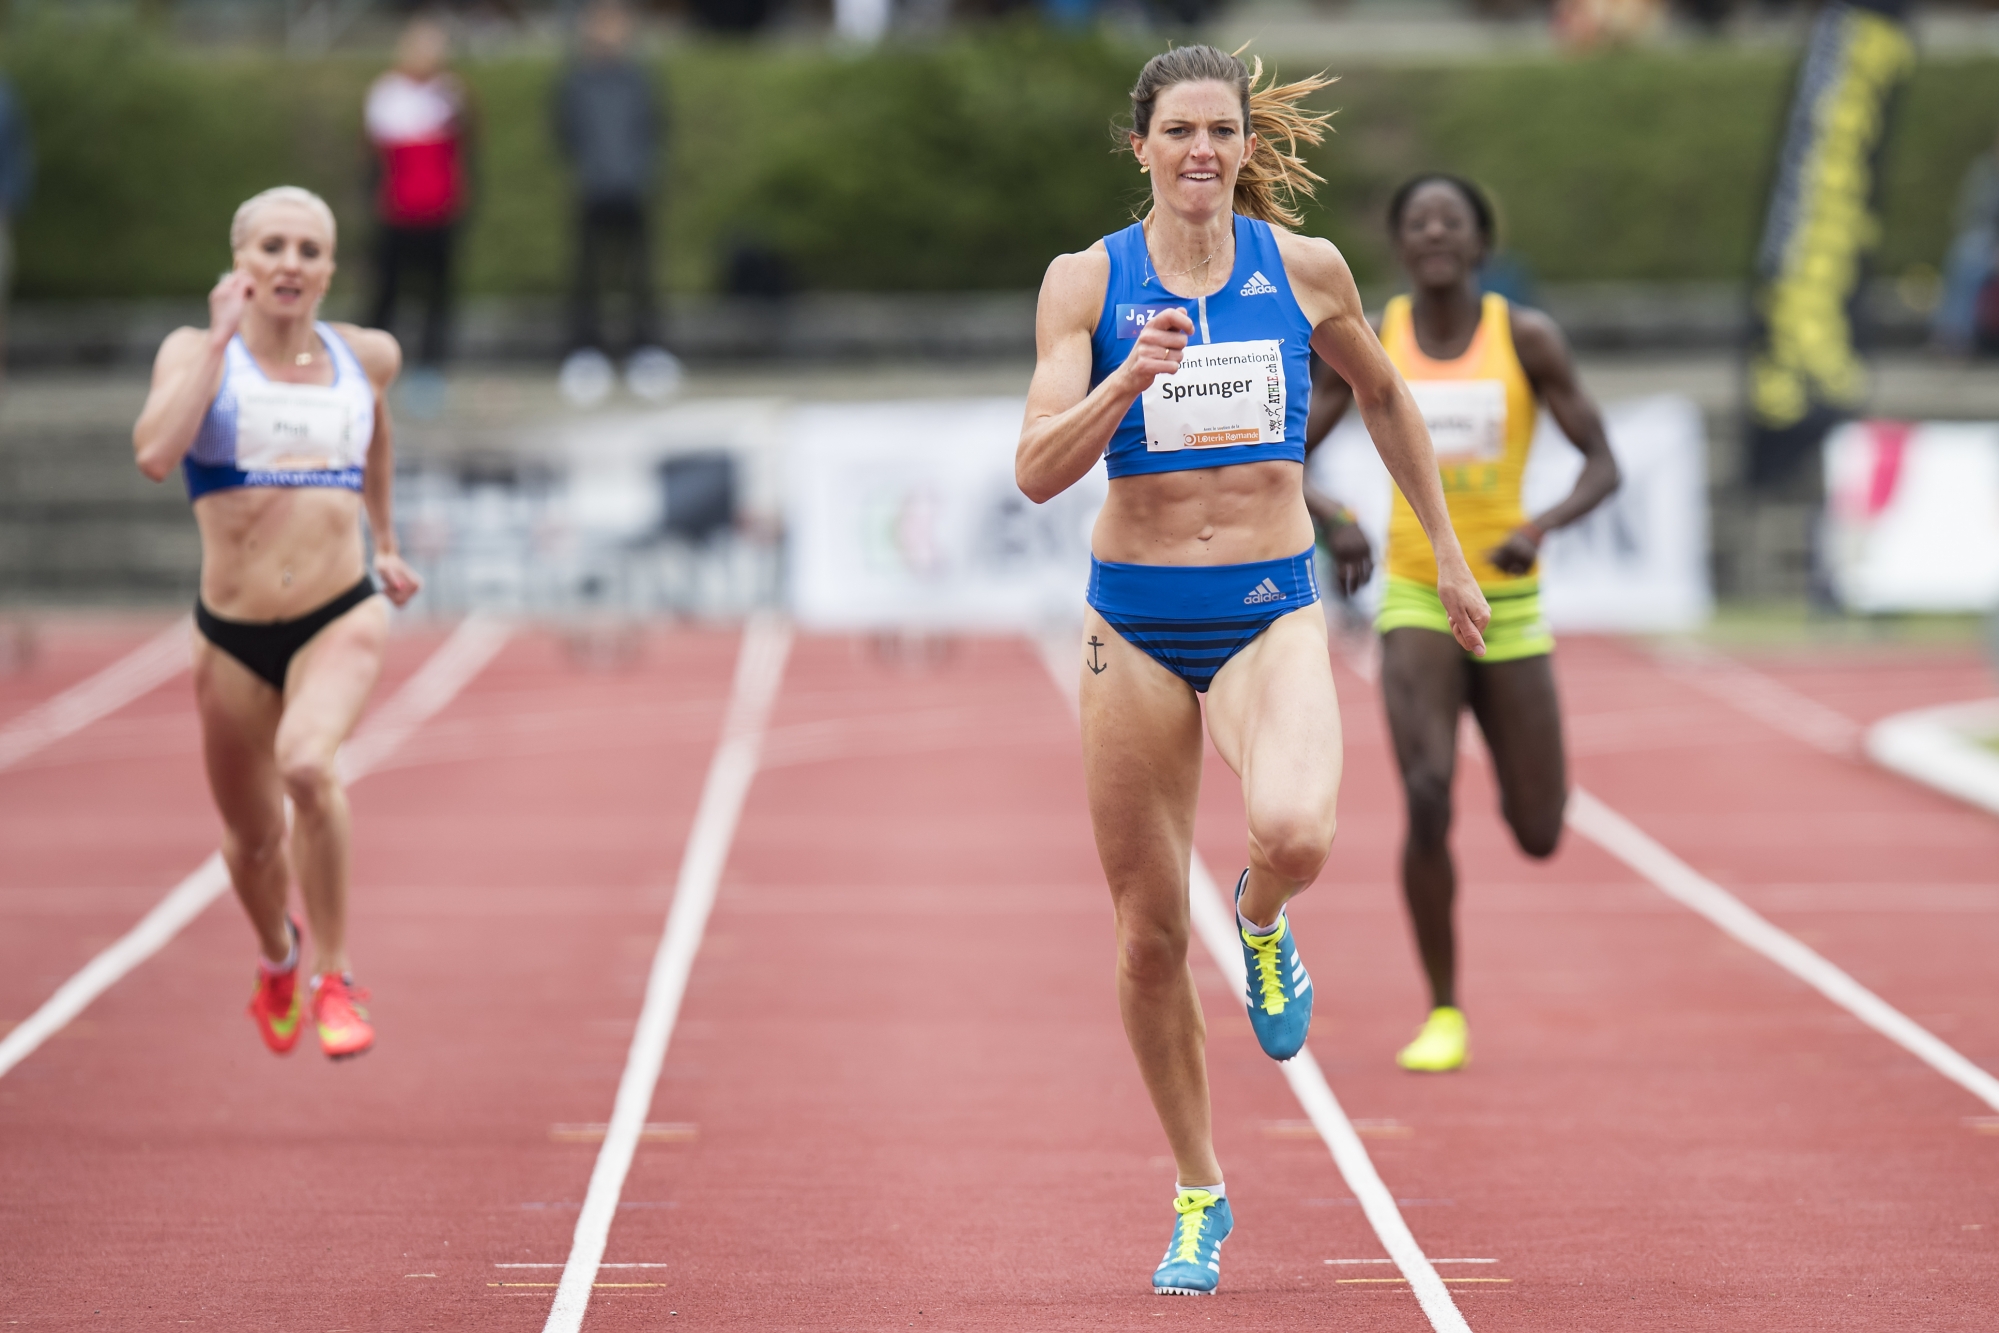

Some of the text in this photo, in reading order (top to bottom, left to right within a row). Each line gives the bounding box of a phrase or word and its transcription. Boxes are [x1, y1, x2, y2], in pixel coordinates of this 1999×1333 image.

[1240, 285, 1278, 297] adidas
[1205, 351, 1279, 367] International
[1162, 378, 1253, 402] Sprunger
[1197, 431, 1259, 443] Loterie Romande
[1244, 593, 1287, 604] adidas
